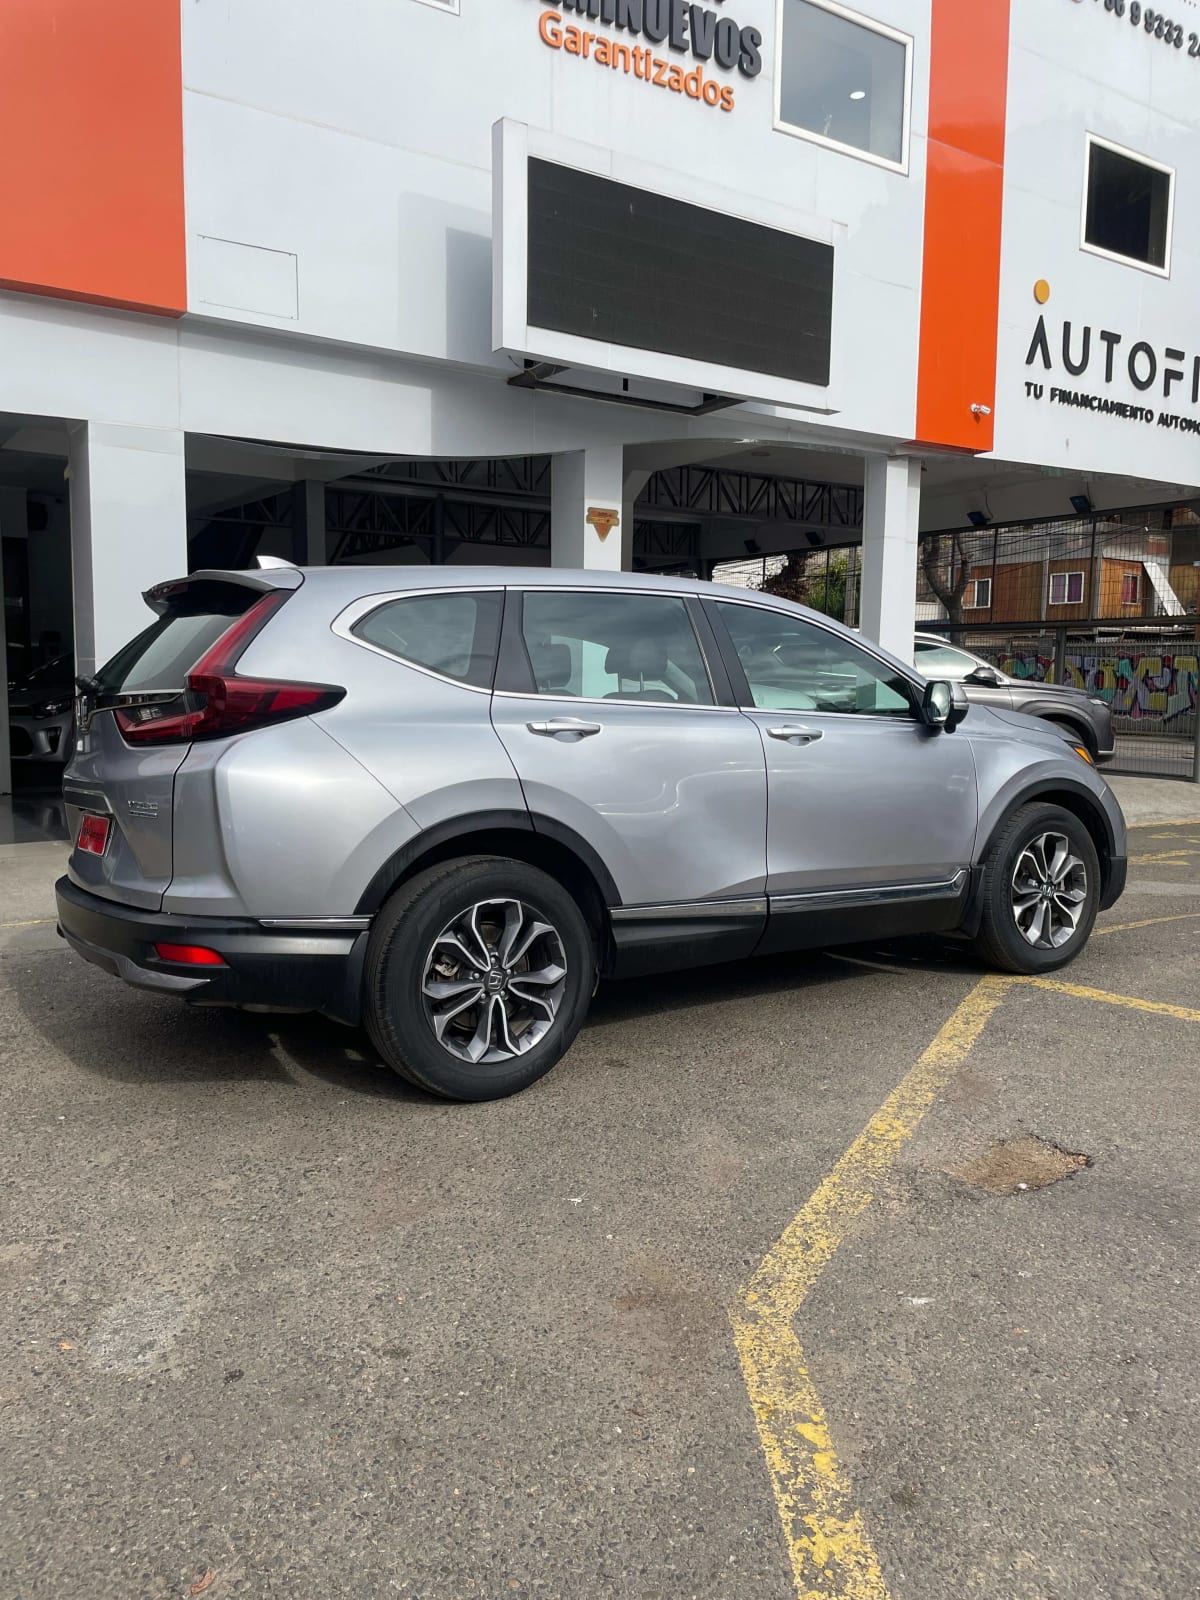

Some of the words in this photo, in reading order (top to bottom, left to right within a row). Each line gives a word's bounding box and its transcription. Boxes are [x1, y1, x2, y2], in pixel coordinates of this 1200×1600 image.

[534, 0, 761, 77] NUEVOS
[538, 10, 734, 111] Garantizados
[1130, 1, 1141, 26] 9
[1188, 32, 1200, 58] 2
[1025, 381, 1044, 400] TU
[1050, 387, 1154, 423] FINANCIAMIENTO
